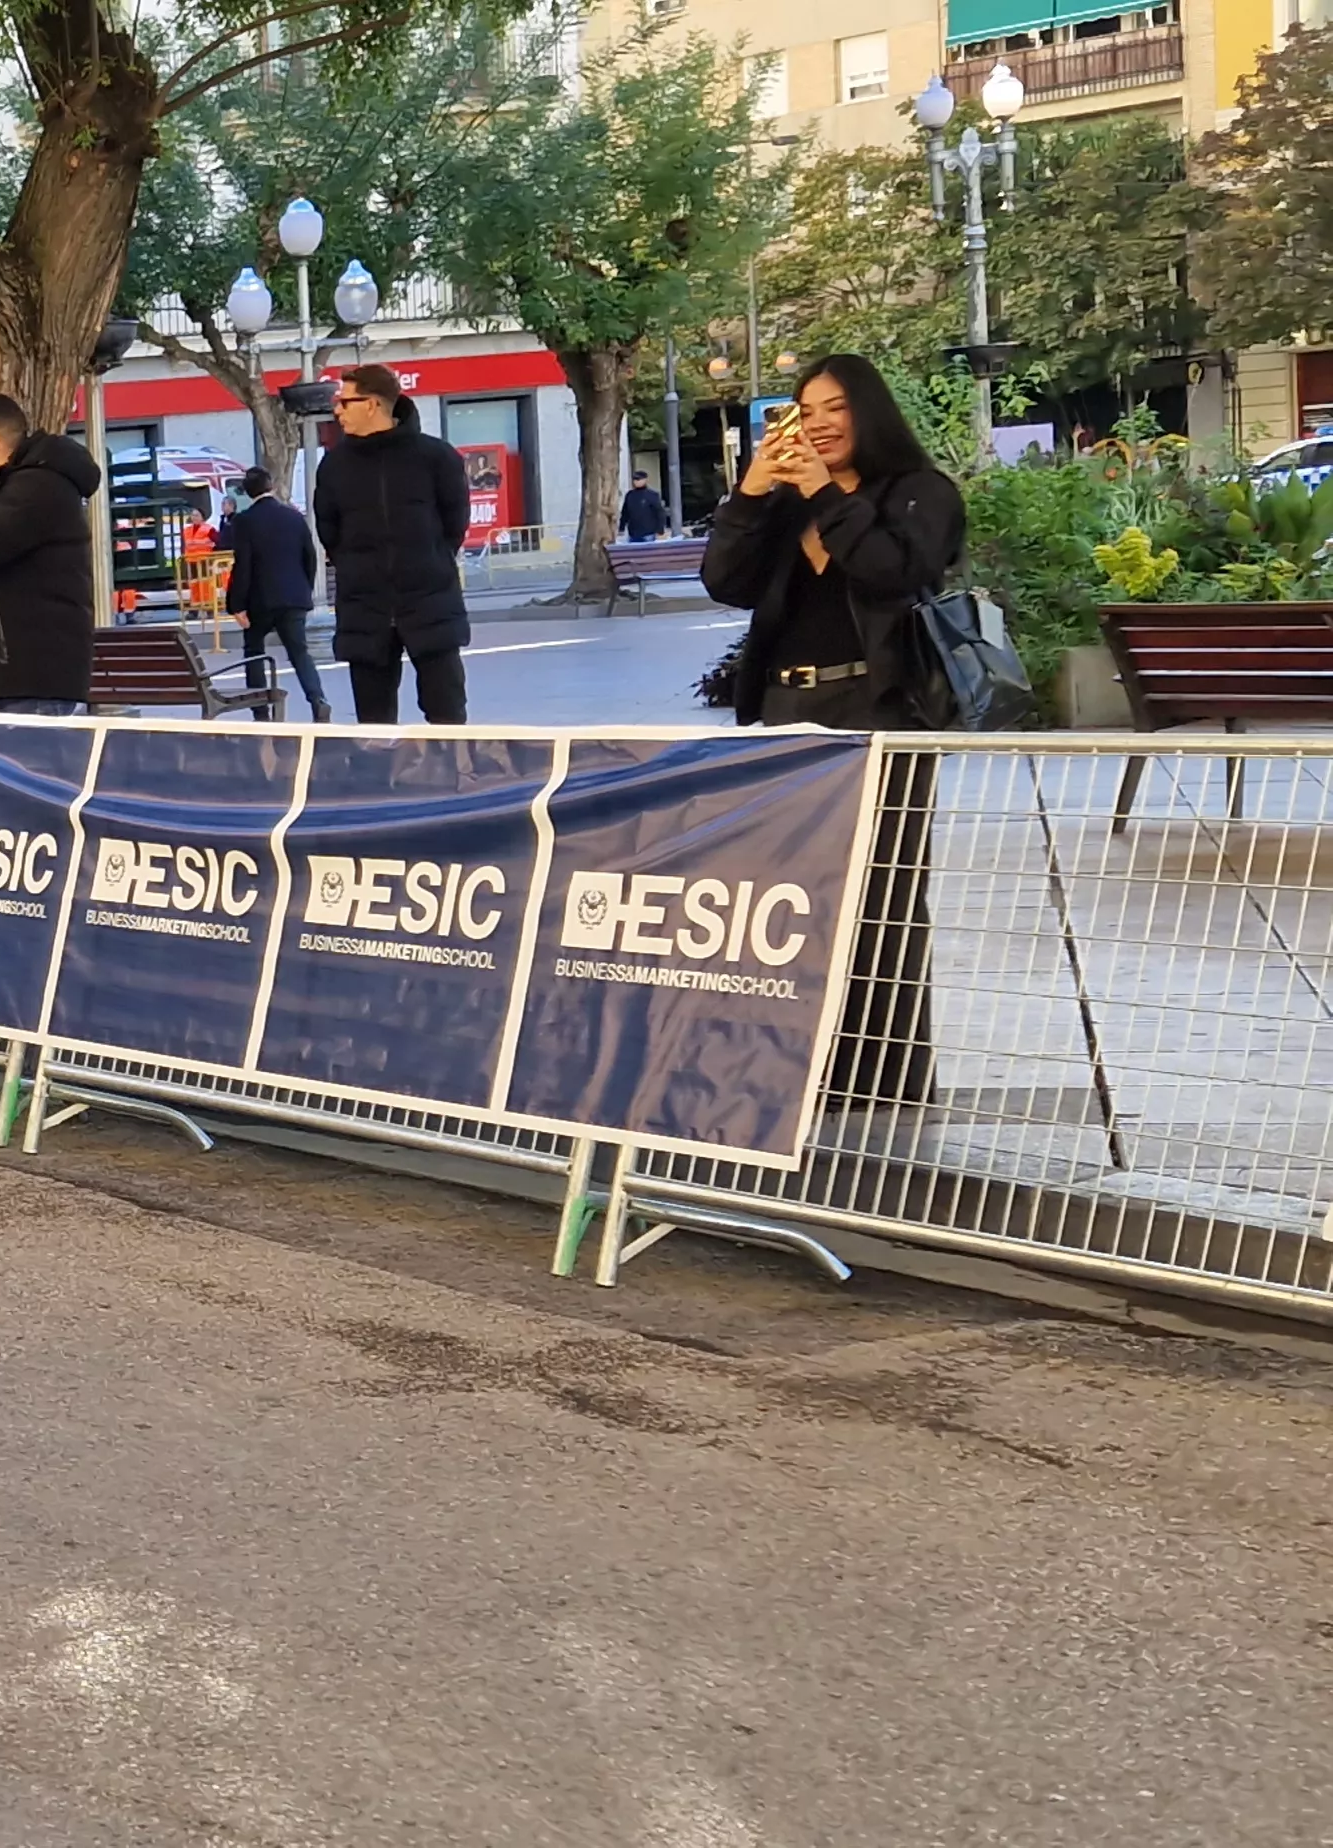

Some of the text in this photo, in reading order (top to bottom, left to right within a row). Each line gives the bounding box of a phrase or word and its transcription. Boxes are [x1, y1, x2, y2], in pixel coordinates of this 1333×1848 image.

[134, 842, 258, 917] ESIC
[352, 857, 506, 941] ESIC
[621, 874, 810, 966] ESIC
